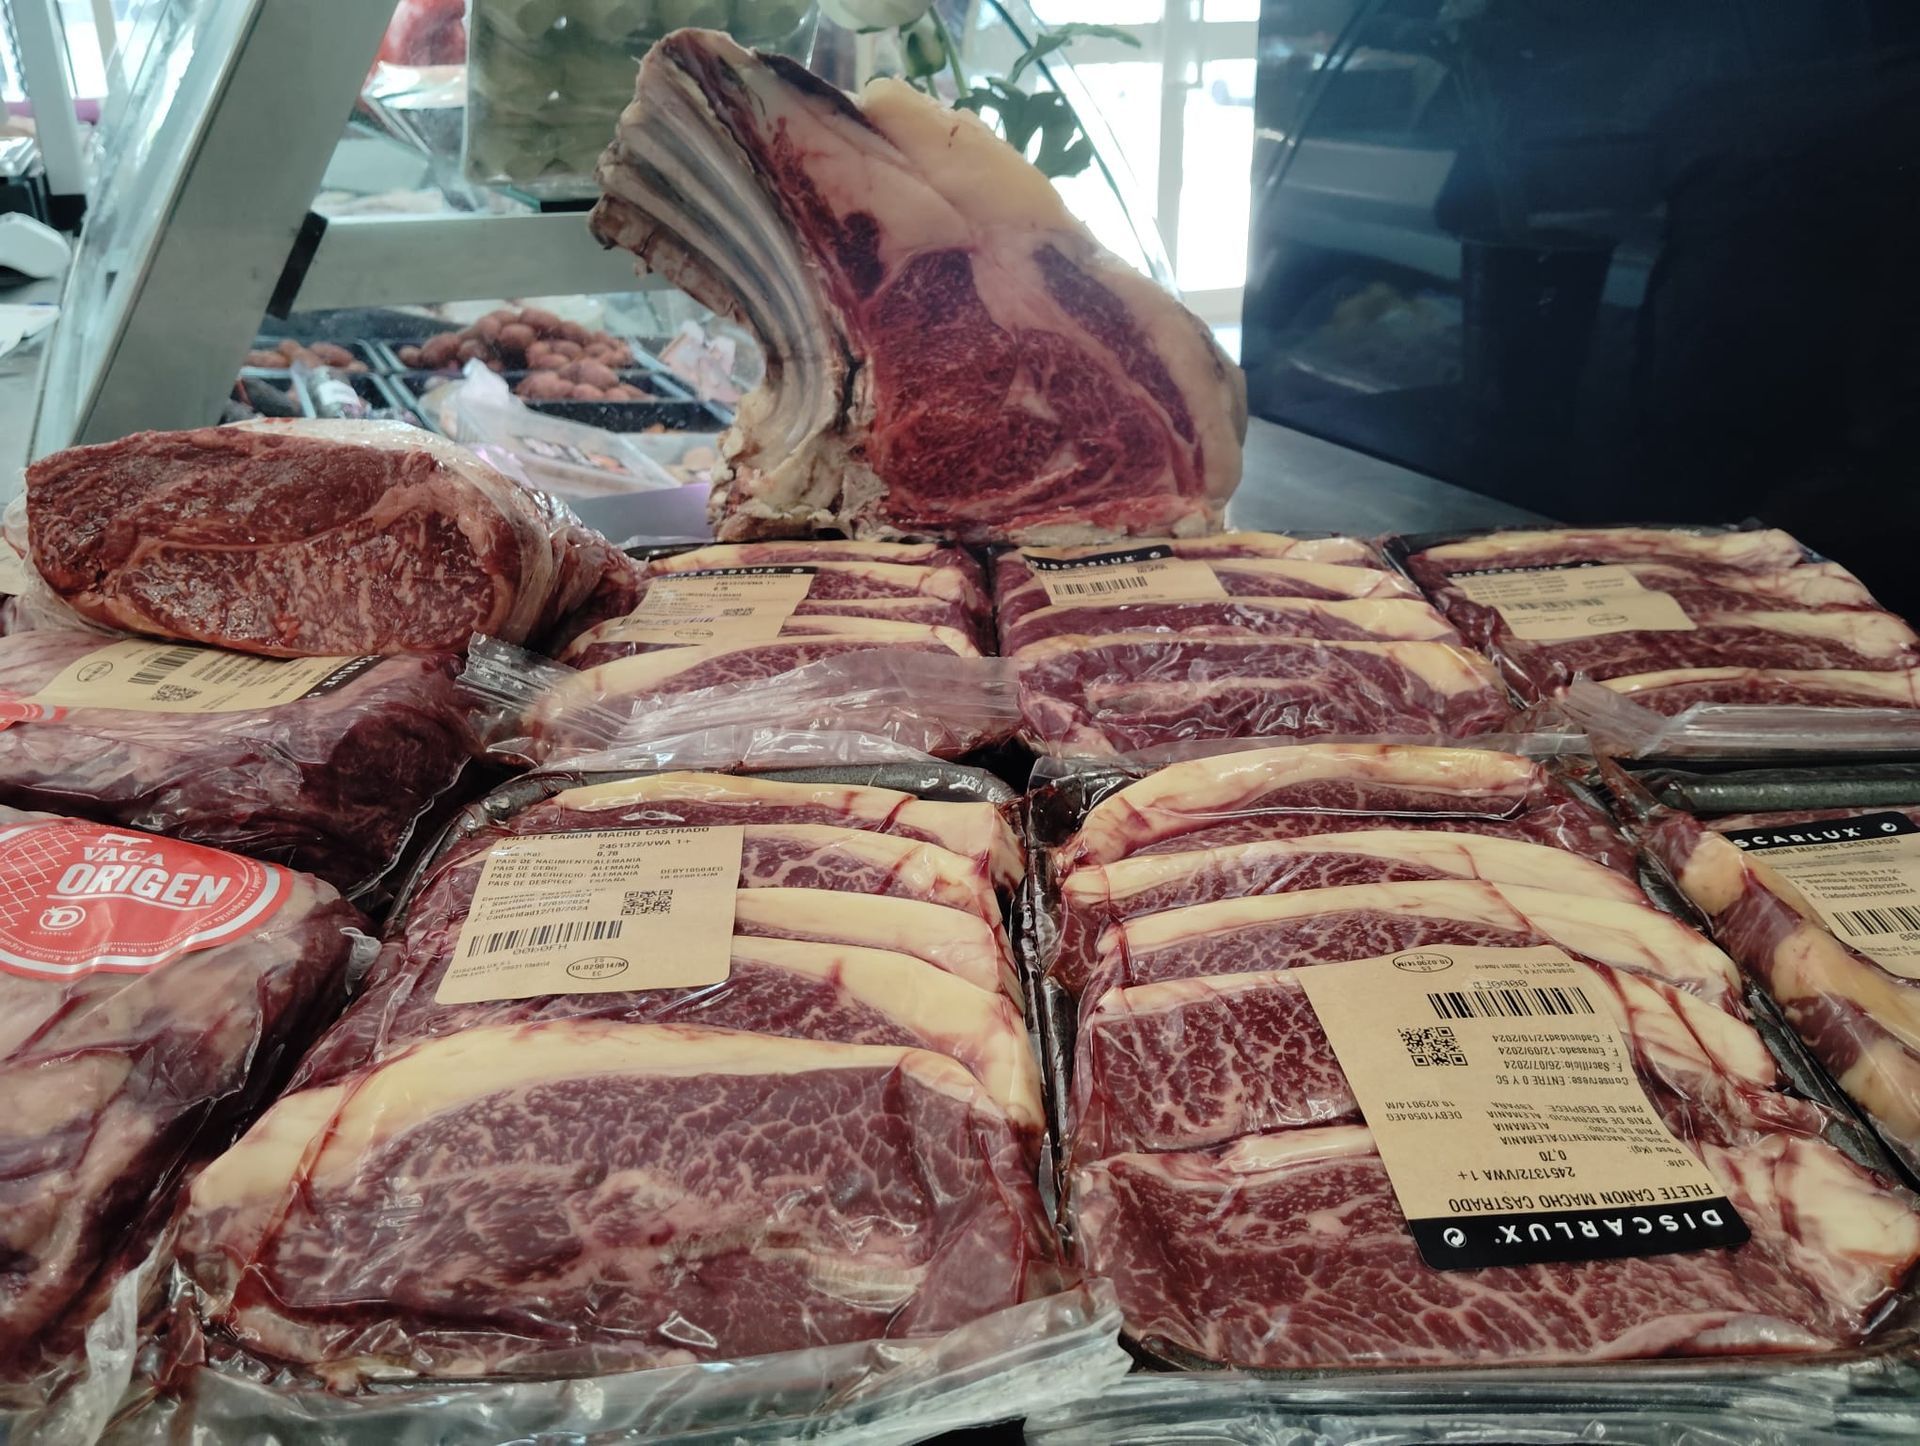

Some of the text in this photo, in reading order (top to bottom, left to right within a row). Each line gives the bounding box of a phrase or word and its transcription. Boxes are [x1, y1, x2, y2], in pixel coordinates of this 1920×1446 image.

[596, 830, 641, 838] MACHO
[645, 827, 710, 836] CASTRADO
[1732, 826, 1860, 848] SCARLUX
[83, 846, 165, 867] VACA
[56, 863, 232, 906] ORIGEN
[1495, 1074, 1510, 1085] 5C
[1512, 1074, 1521, 1085] Y
[1531, 1075, 1566, 1086] ENTRE
[1600, 1105, 1617, 1113] DE
[1618, 1105, 1644, 1113] PAIS
[1485, 1110, 1542, 1120] ALEMANIA
[1610, 1116, 1624, 1125] DE
[1626, 1116, 1653, 1125] PAIS
[1492, 1121, 1550, 1132] ALEMANIA
[1619, 1127, 1634, 1135] DE
[1538, 1148, 1567, 1162] 0,70
[1663, 1159, 1693, 1168] Lote:
[1482, 1166, 1576, 1181] 2451372/VWA
[1448, 1183, 1714, 1213] FILETE CAÑON MACHO CASTRADO
[1498, 1209, 1724, 1244] DISCARLUX
